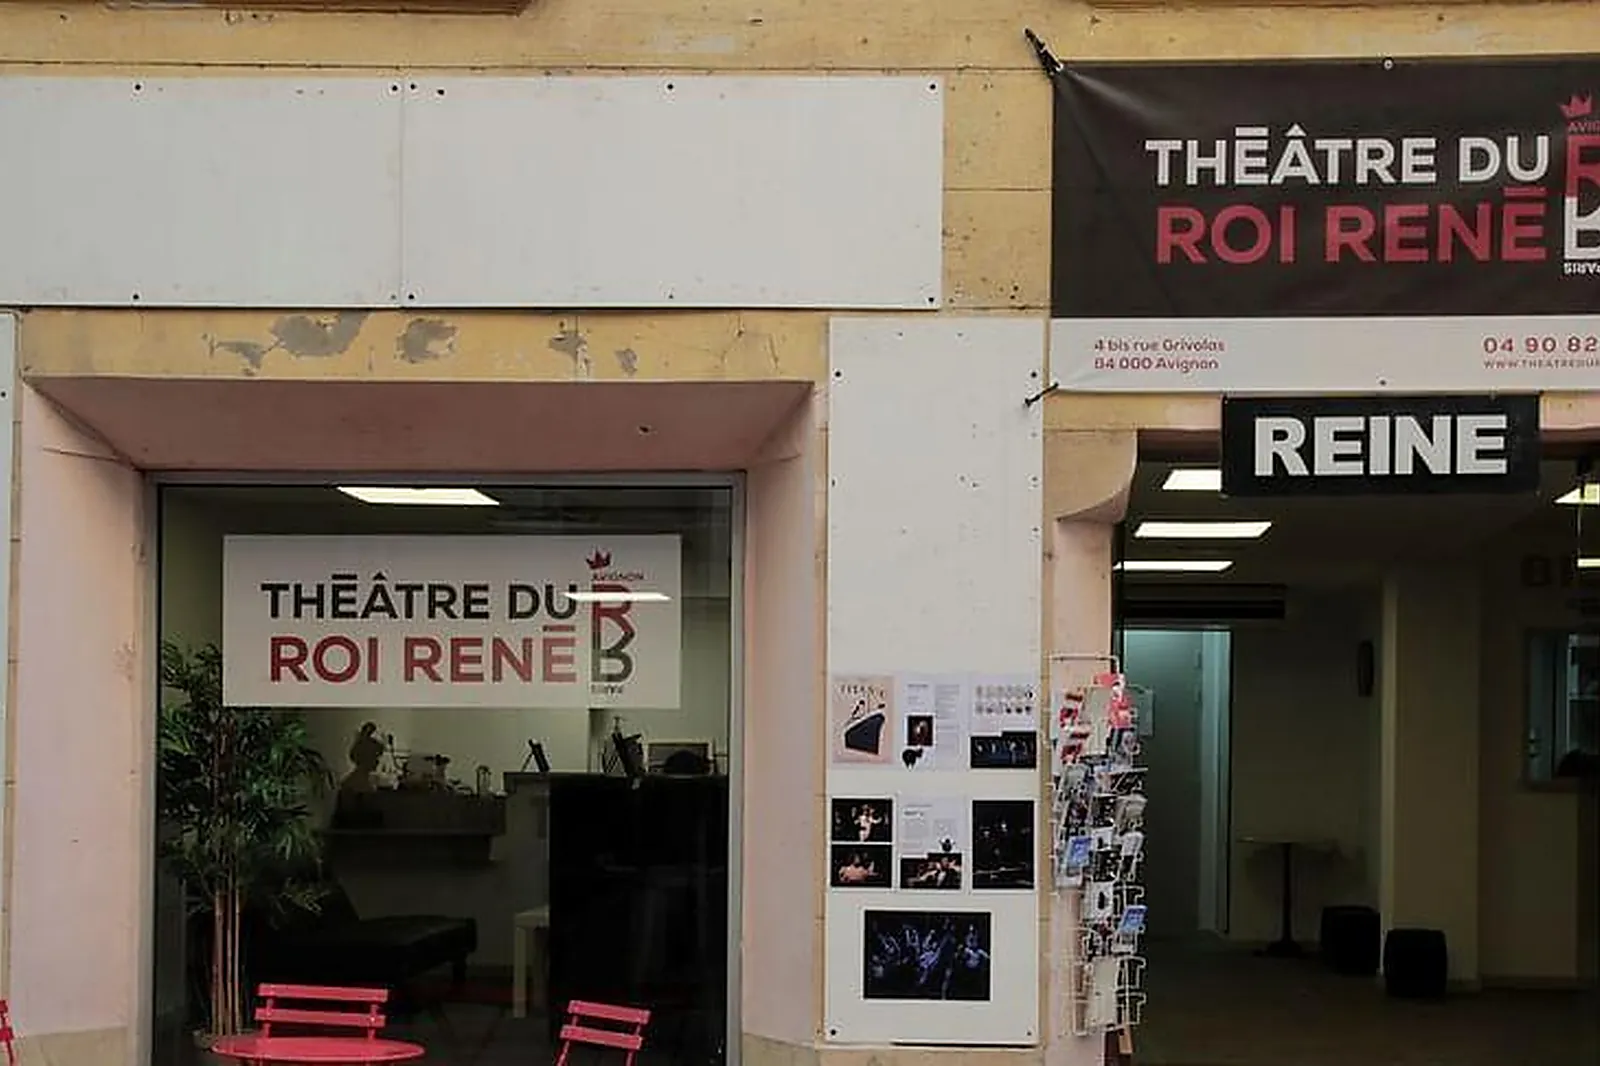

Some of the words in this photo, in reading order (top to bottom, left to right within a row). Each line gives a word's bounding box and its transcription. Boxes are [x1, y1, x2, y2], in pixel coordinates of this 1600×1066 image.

[1459, 135, 1549, 183] DU
[1156, 206, 1295, 264] ROI
[1094, 338, 1104, 352] 4
[1107, 338, 1130, 352] bis
[1134, 340, 1160, 352] rue
[1119, 356, 1152, 370] 000
[1155, 357, 1220, 374] Avignon
[1484, 336, 1514, 354] 04
[1525, 336, 1557, 354] 90
[1567, 335, 1599, 353] 82
[1254, 414, 1508, 477] REINE
[508, 582, 577, 619] DU
[270, 634, 378, 683] ROI
